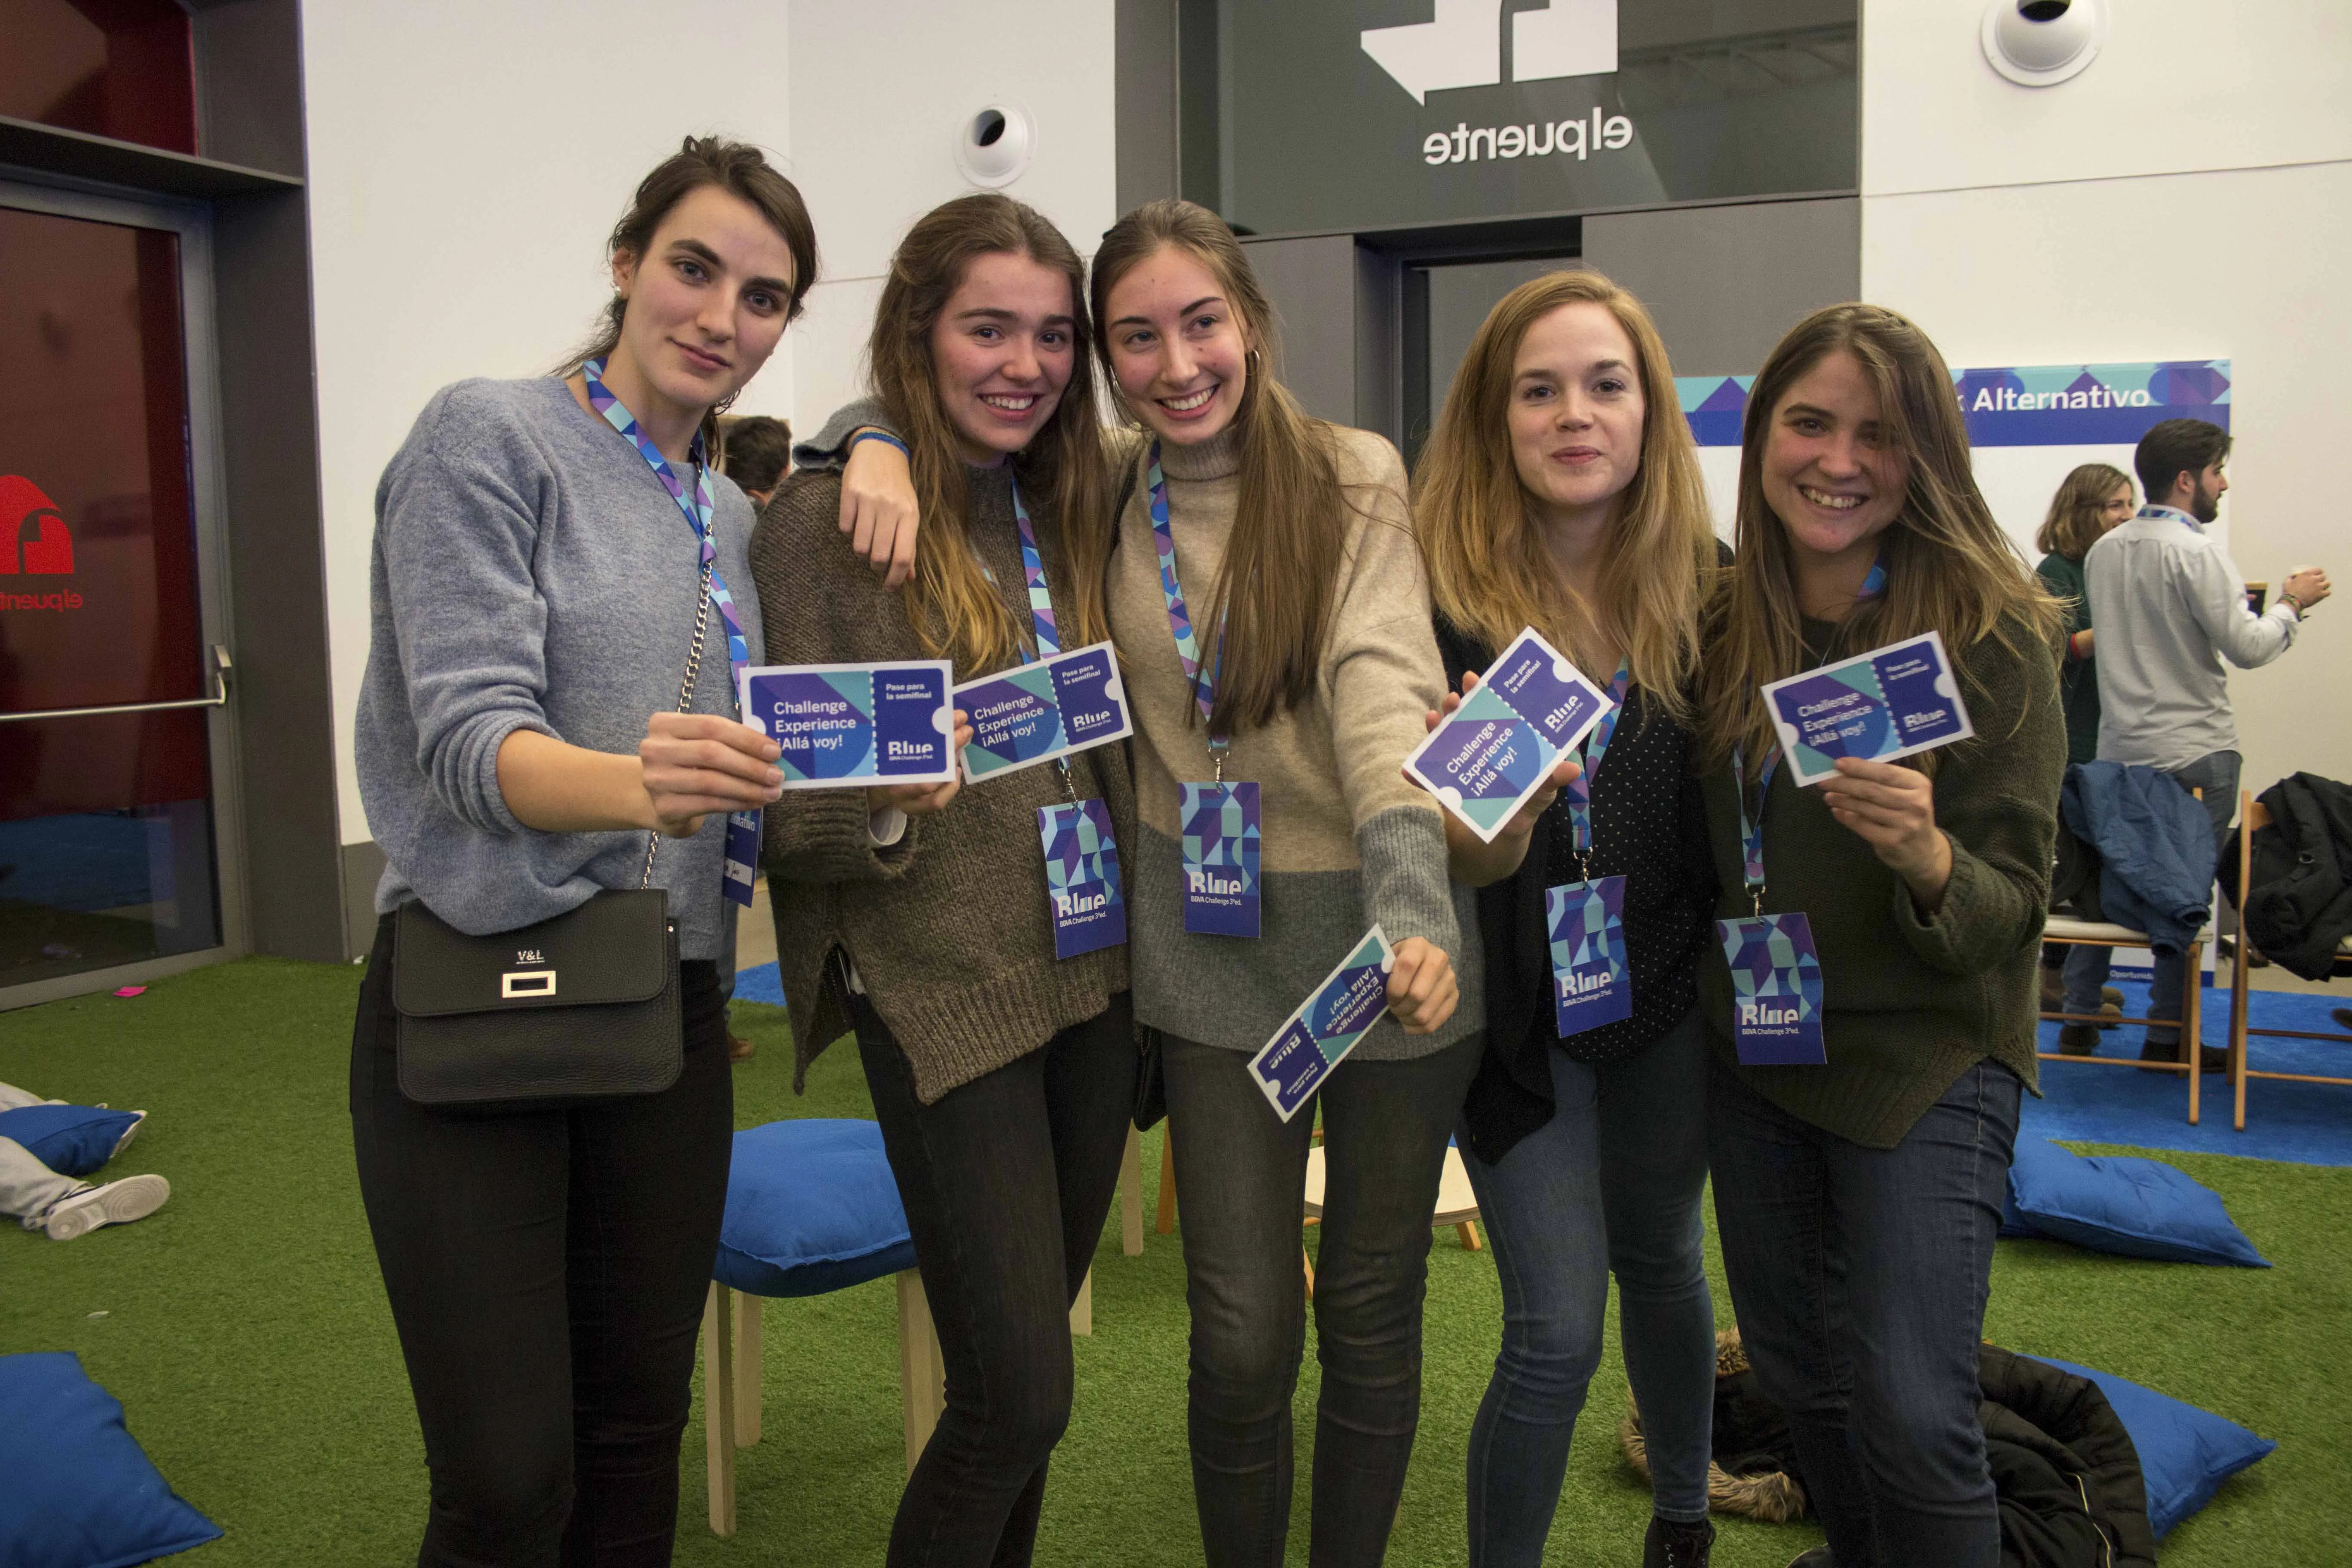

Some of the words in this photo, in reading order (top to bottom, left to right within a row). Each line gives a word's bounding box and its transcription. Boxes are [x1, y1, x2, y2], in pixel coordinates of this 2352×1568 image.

[1972, 385, 2150, 412] Alternativo
[1062, 669, 1078, 678] Pase
[1079, 665, 1093, 674] para
[1071, 669, 1100, 683] semifinal
[1504, 673, 1519, 688] Pase
[1517, 660, 1531, 675] para
[1517, 660, 1541, 688] semifinal
[895, 691, 932, 700] semifinal
[974, 695, 1034, 720] Challenge
[1797, 693, 1861, 717] Challenge
[774, 701, 847, 715] Challenge
[1802, 705, 1873, 732] Experience
[775, 718, 856, 735] Experience
[978, 707, 1044, 734] Experience
[813, 734, 842, 750] voy!
[982, 730, 1010, 747] ¡Allá
[1011, 721, 1036, 738] voy!
[1446, 722, 1496, 773] Challenge
[1458, 728, 1513, 786] Experience
[1470, 769, 1498, 796] ¡Allá
[1494, 746, 1517, 771] voy!
[1205, 896, 1229, 906] Challenge
[1072, 914, 1095, 925] Challenge
[518, 949, 544, 961] V&L
[1326, 976, 1379, 1031] Experience
[1329, 992, 1351, 1015] voy!
[1336, 986, 1383, 1034] Challenge
[1757, 1028, 1784, 1036] Challenge
